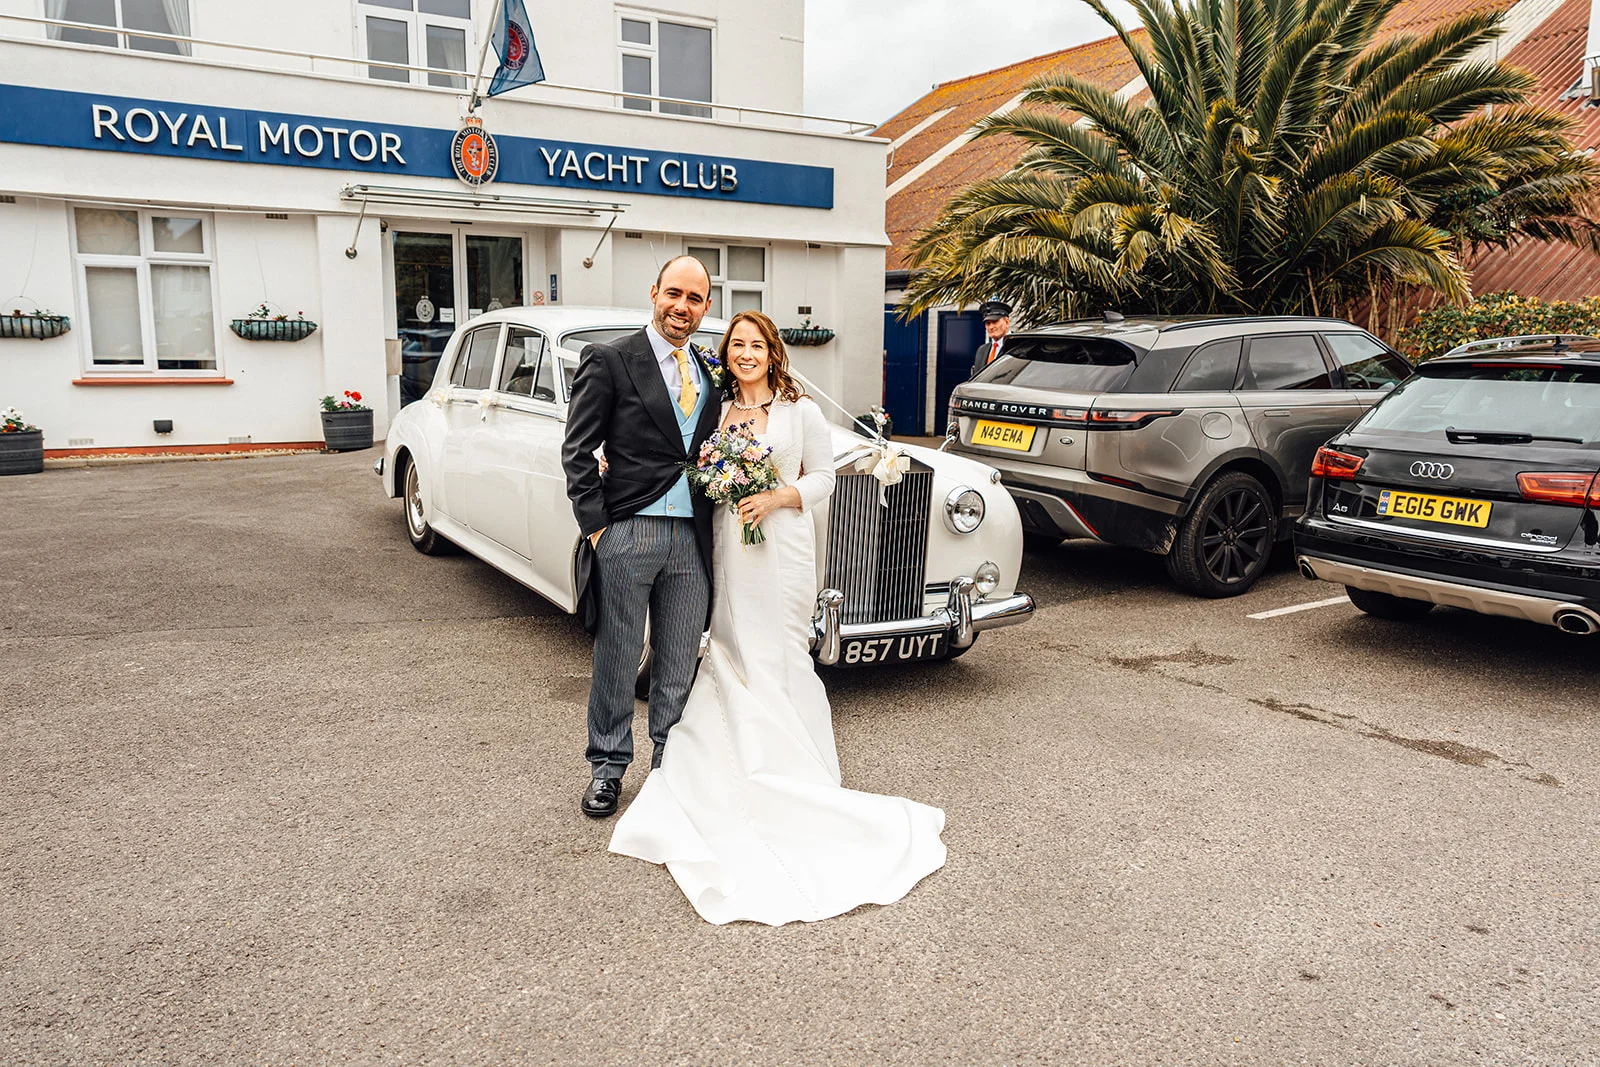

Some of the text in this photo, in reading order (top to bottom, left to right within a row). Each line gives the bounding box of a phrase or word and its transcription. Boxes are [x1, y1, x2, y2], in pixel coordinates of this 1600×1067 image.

[92, 104, 738, 191] ROYAL MOTOR YACHT CLUB
[455, 138, 463, 158] ROYAL
[486, 159, 496, 175] CLUB
[962, 400, 1047, 415] RANGE ROVER
[981, 426, 1024, 443] N49 EMA
[1393, 495, 1483, 523] EG15 GWK
[845, 633, 943, 664] 857 UYT
